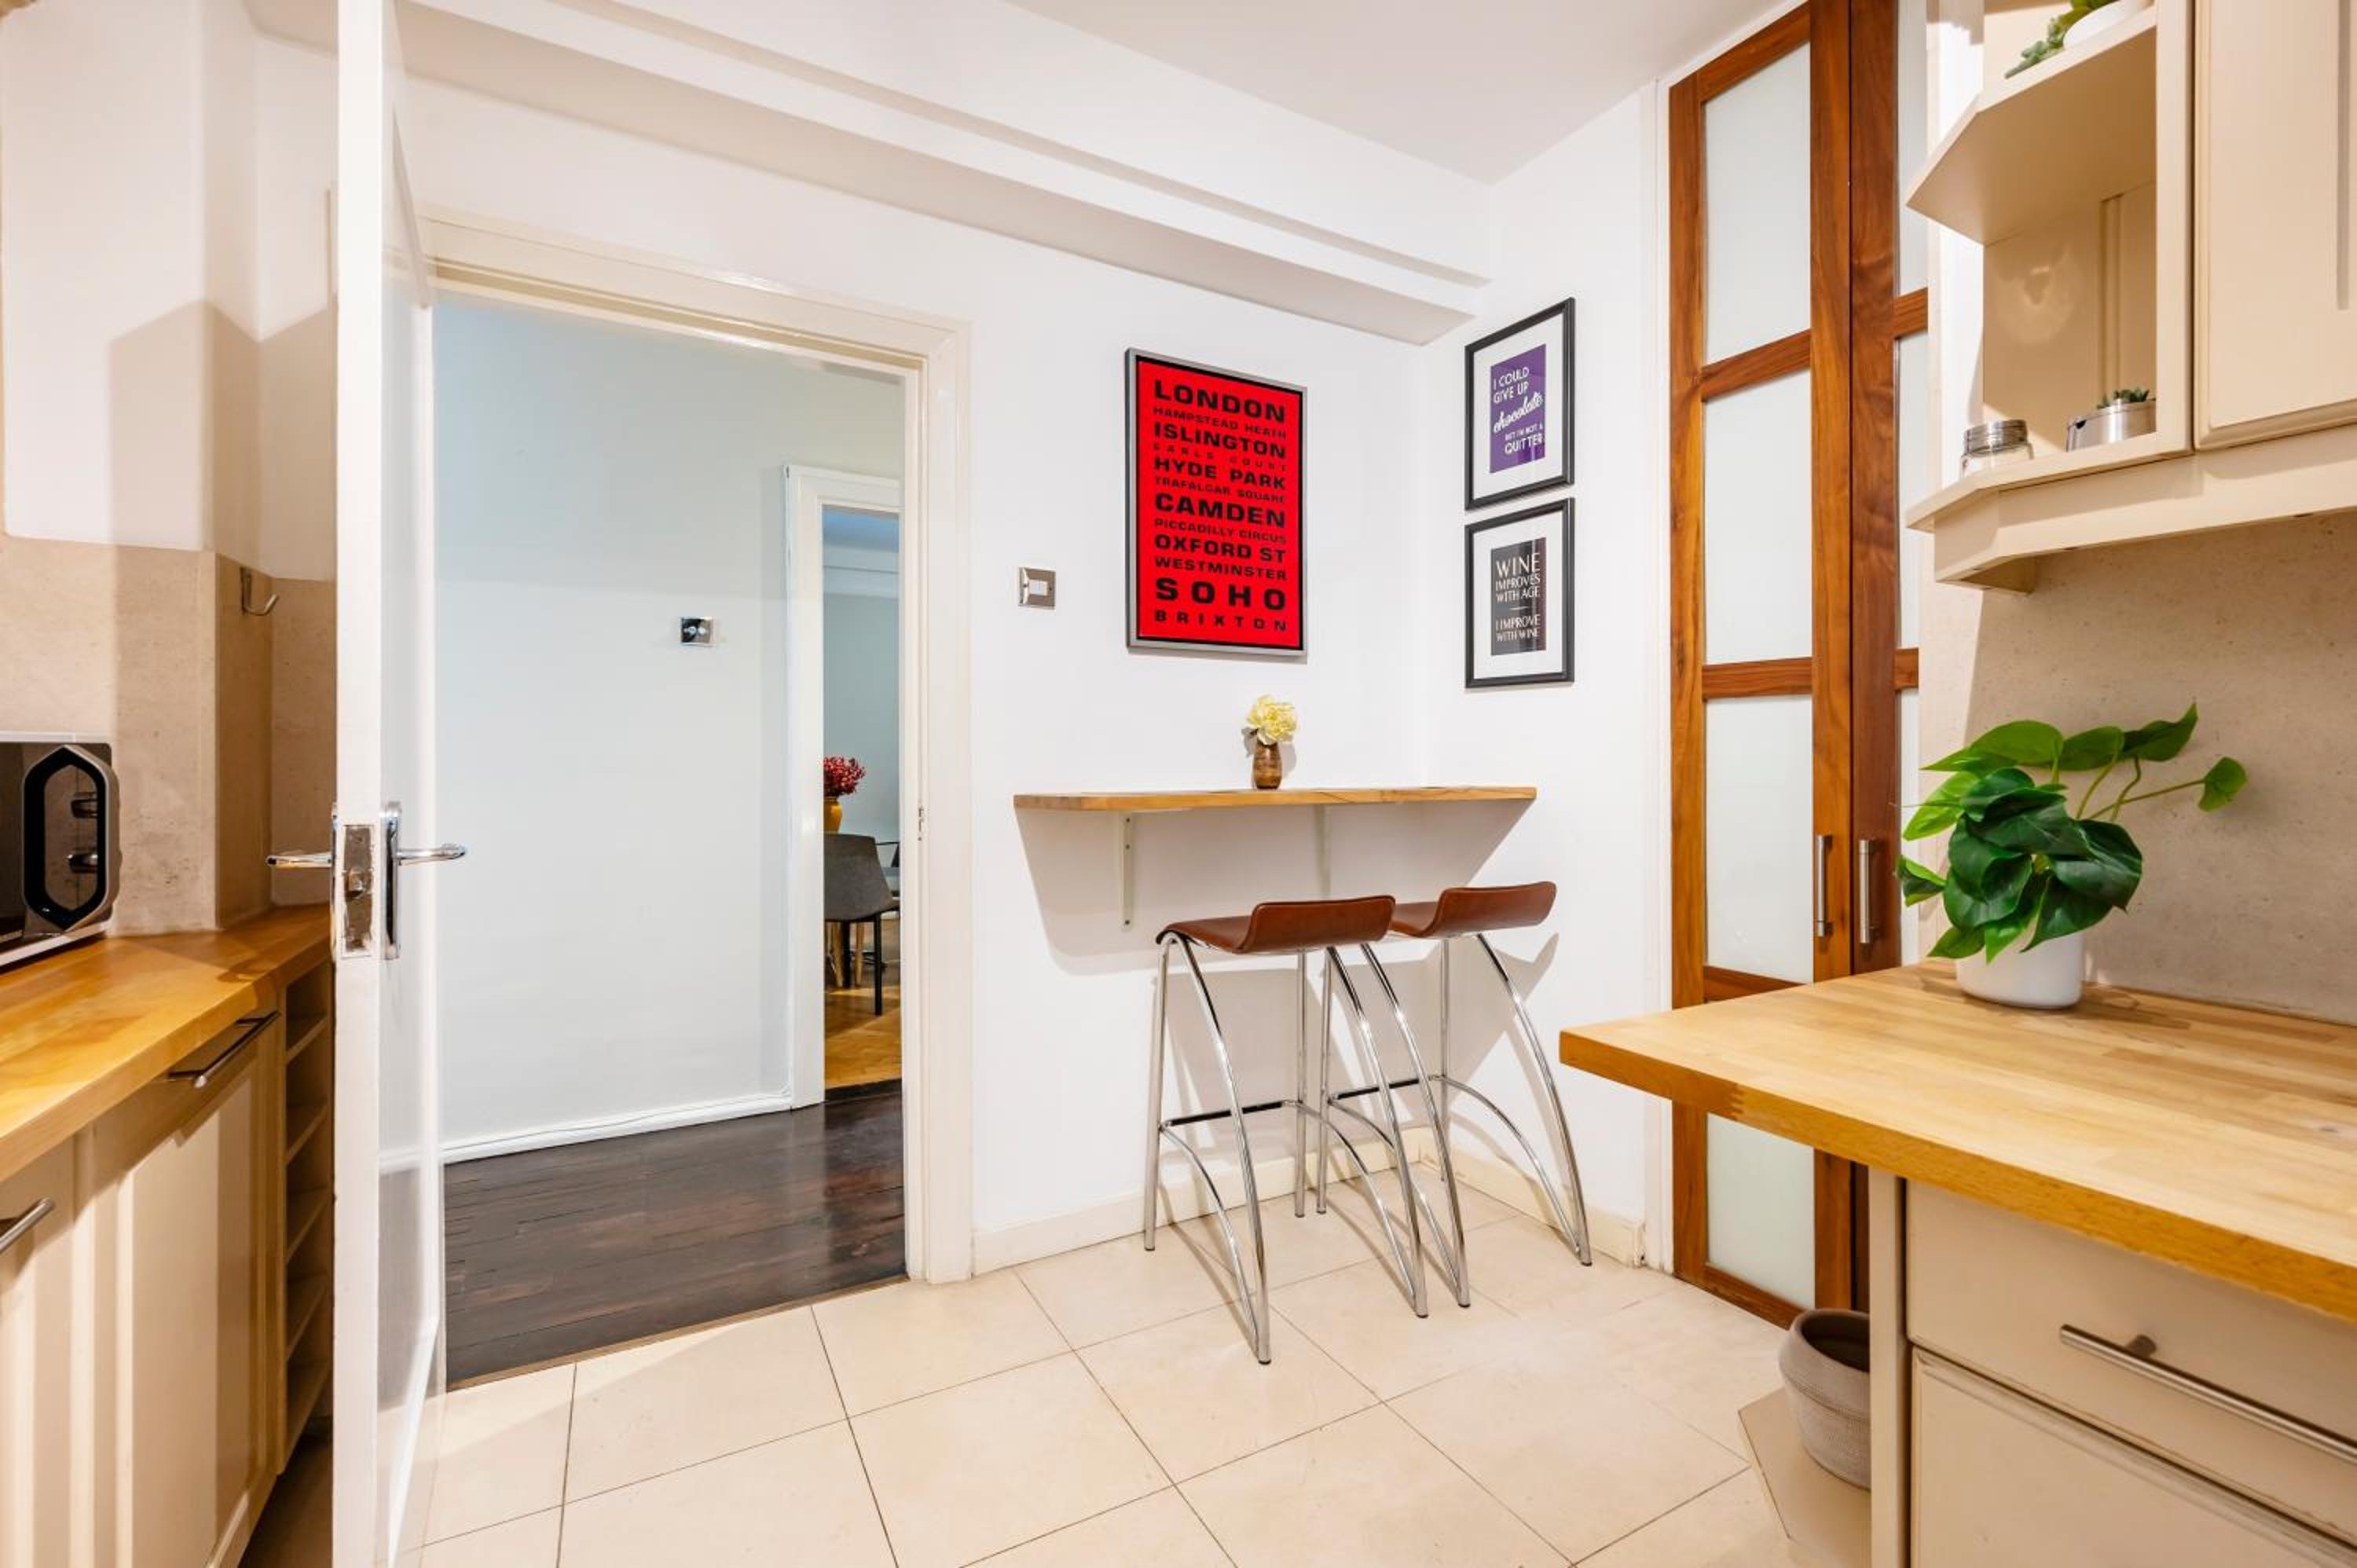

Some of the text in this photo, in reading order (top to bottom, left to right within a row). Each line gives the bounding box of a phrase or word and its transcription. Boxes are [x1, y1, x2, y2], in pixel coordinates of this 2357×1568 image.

[1498, 367, 1529, 387] COULD
[1154, 379, 1285, 423] LONDON
[1494, 381, 1529, 404] GIVE UP
[1153, 407, 1239, 430] HAMPSTEAD
[1154, 422, 1286, 459] ISLINGTON
[1505, 433, 1542, 454] QUITTER
[1154, 456, 1285, 490] HYDE PARK
[1156, 476, 1285, 504] TRAFALGAR SQUARE
[1155, 492, 1285, 528] CAMDEN
[1154, 518, 1287, 544] PICCADILLY CIRCUS
[1154, 533, 1286, 563] OXFORD ST
[1155, 555, 1287, 581] WESTMINSTER
[1495, 552, 1541, 578] WINE
[1156, 577, 1285, 611] SOHO
[1495, 573, 1541, 592] IMPROVES
[1495, 585, 1541, 604] WITH AGE
[1155, 609, 1286, 632] BRIXTON
[1499, 614, 1541, 631] IMPROVE
[1495, 627, 1540, 642] WITH WINE
